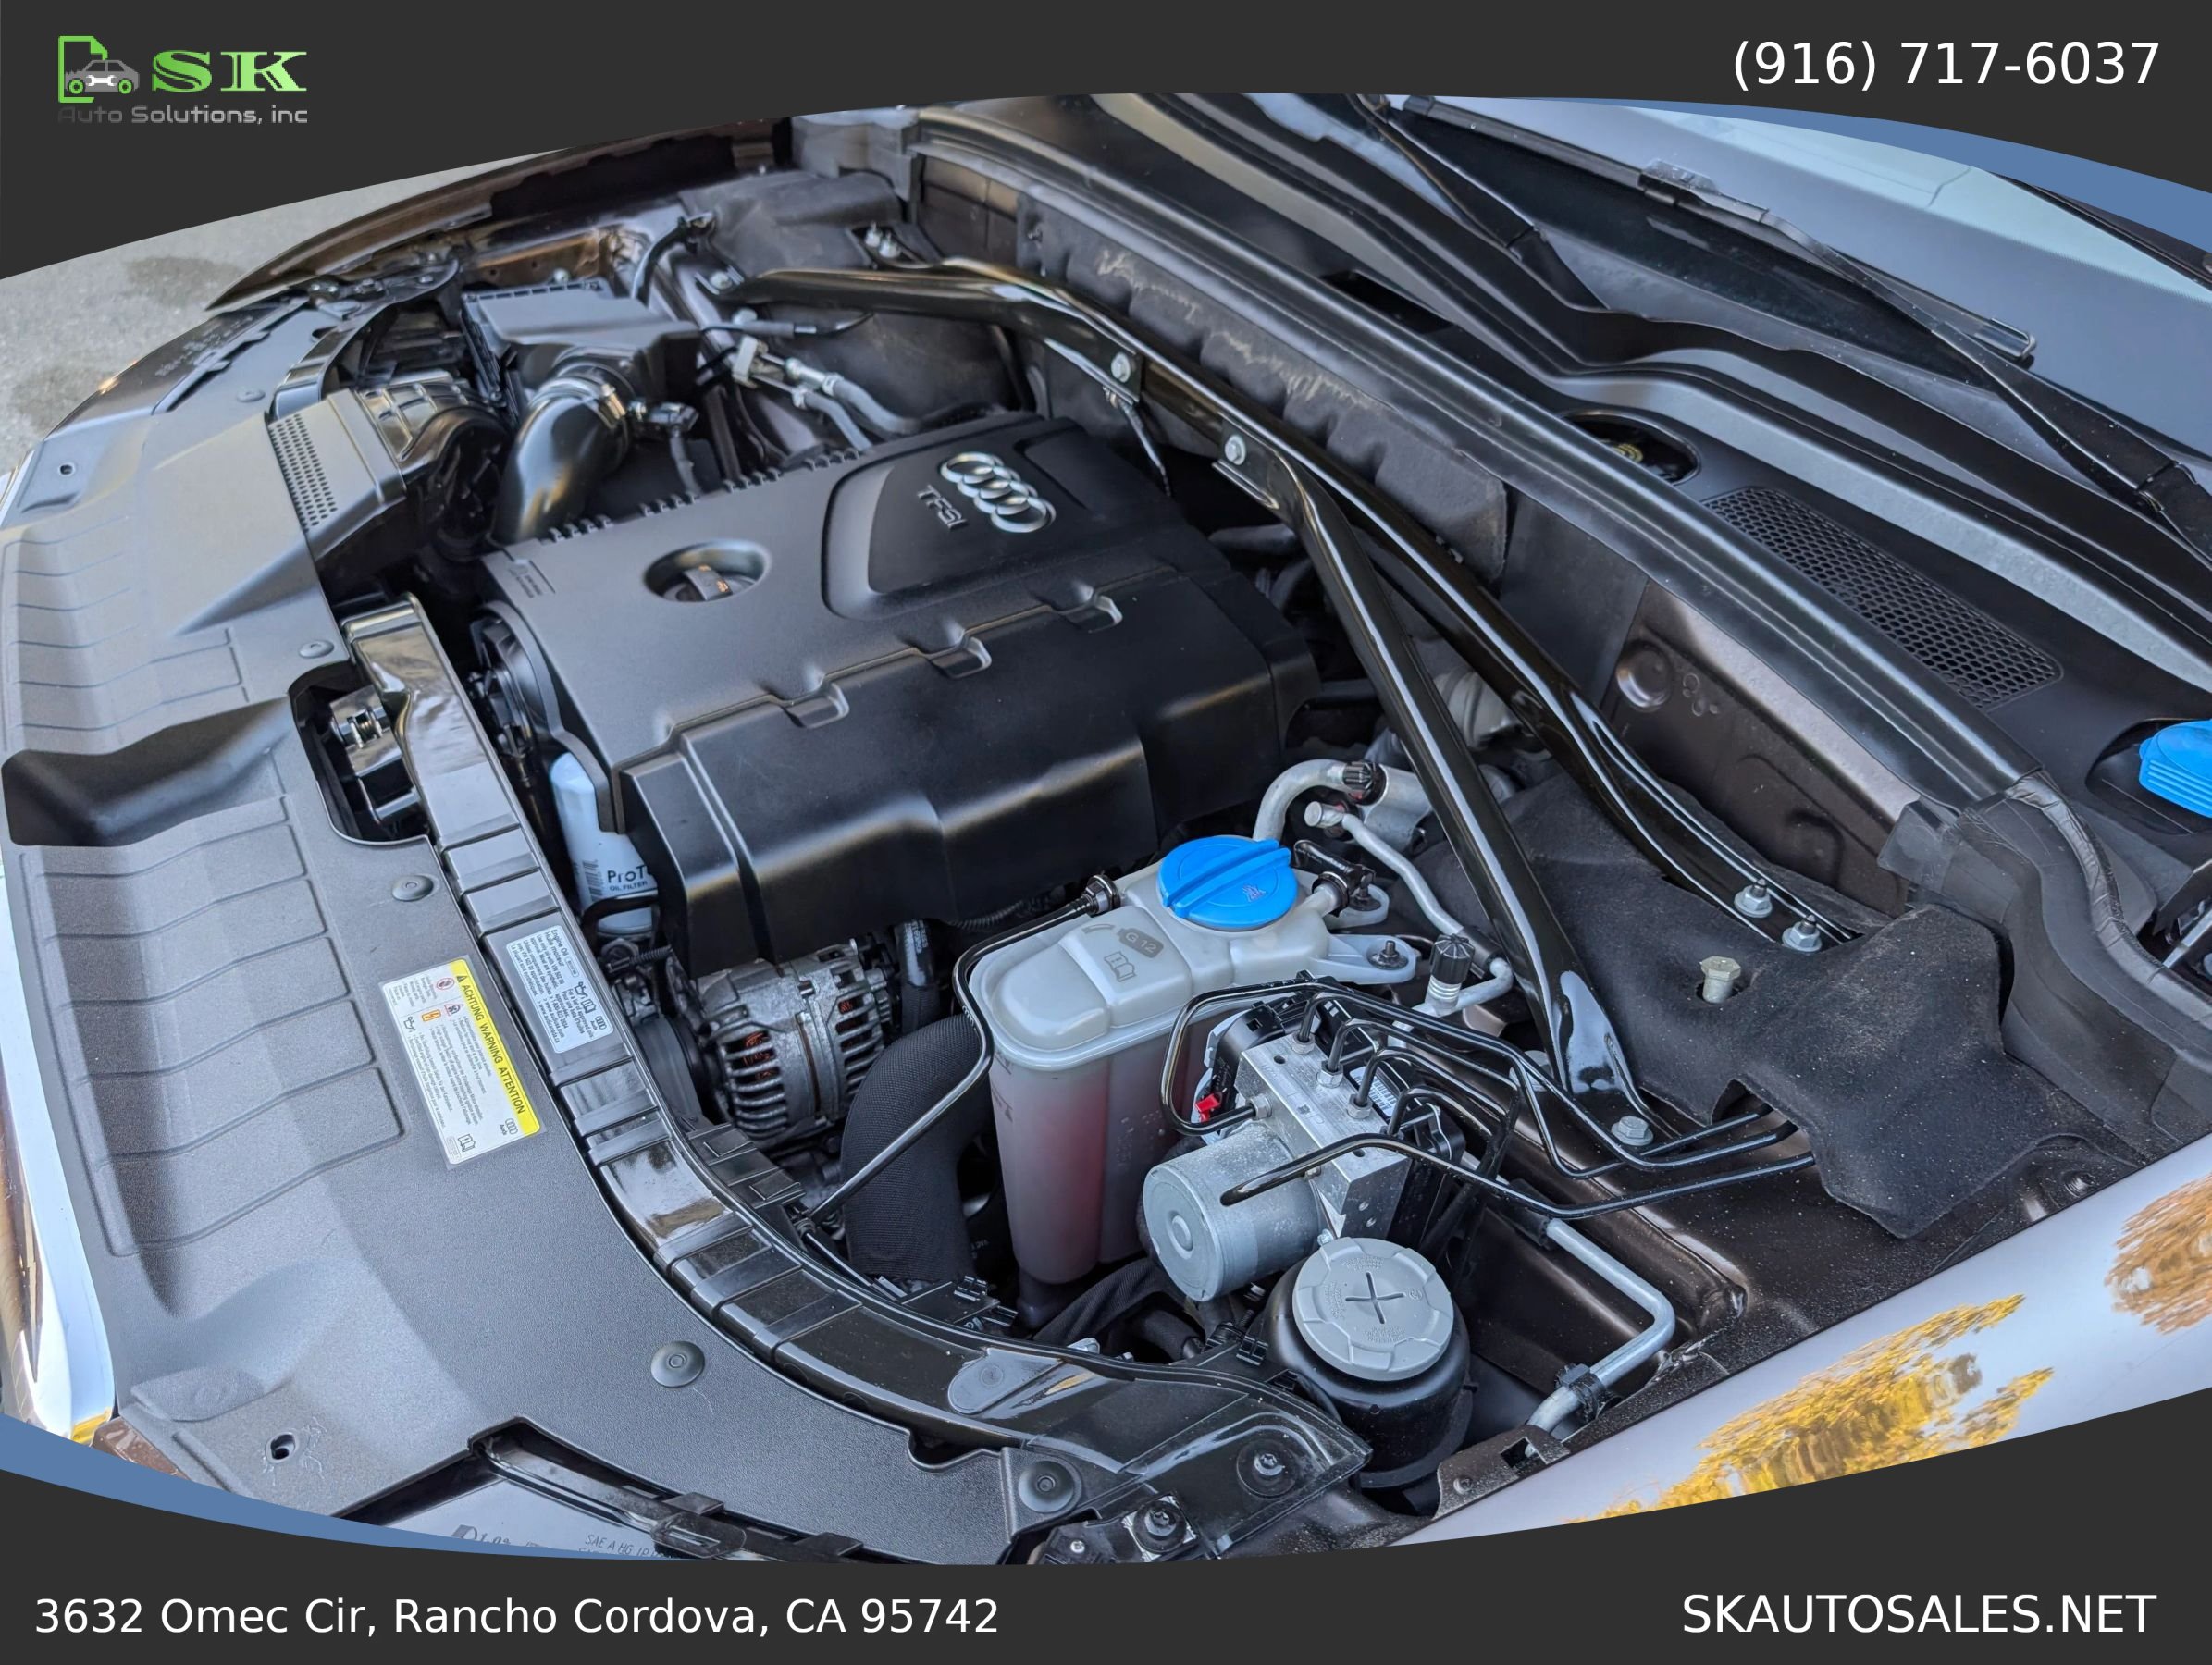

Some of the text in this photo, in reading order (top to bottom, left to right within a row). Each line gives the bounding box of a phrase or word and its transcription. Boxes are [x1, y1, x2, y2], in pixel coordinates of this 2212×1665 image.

[917, 484, 968, 530] TFSI
[623, 881, 648, 890] FILTER
[550, 929, 564, 947] Engine
[1125, 931, 1156, 954] G 12
[550, 945, 564, 967] moteur
[461, 983, 485, 1021] ACHTUNG
[478, 1023, 503, 1064] WARNING
[497, 1066, 525, 1114] ATTENTION
[499, 1123, 508, 1135] Audi
[585, 1534, 607, 1548] SAE
